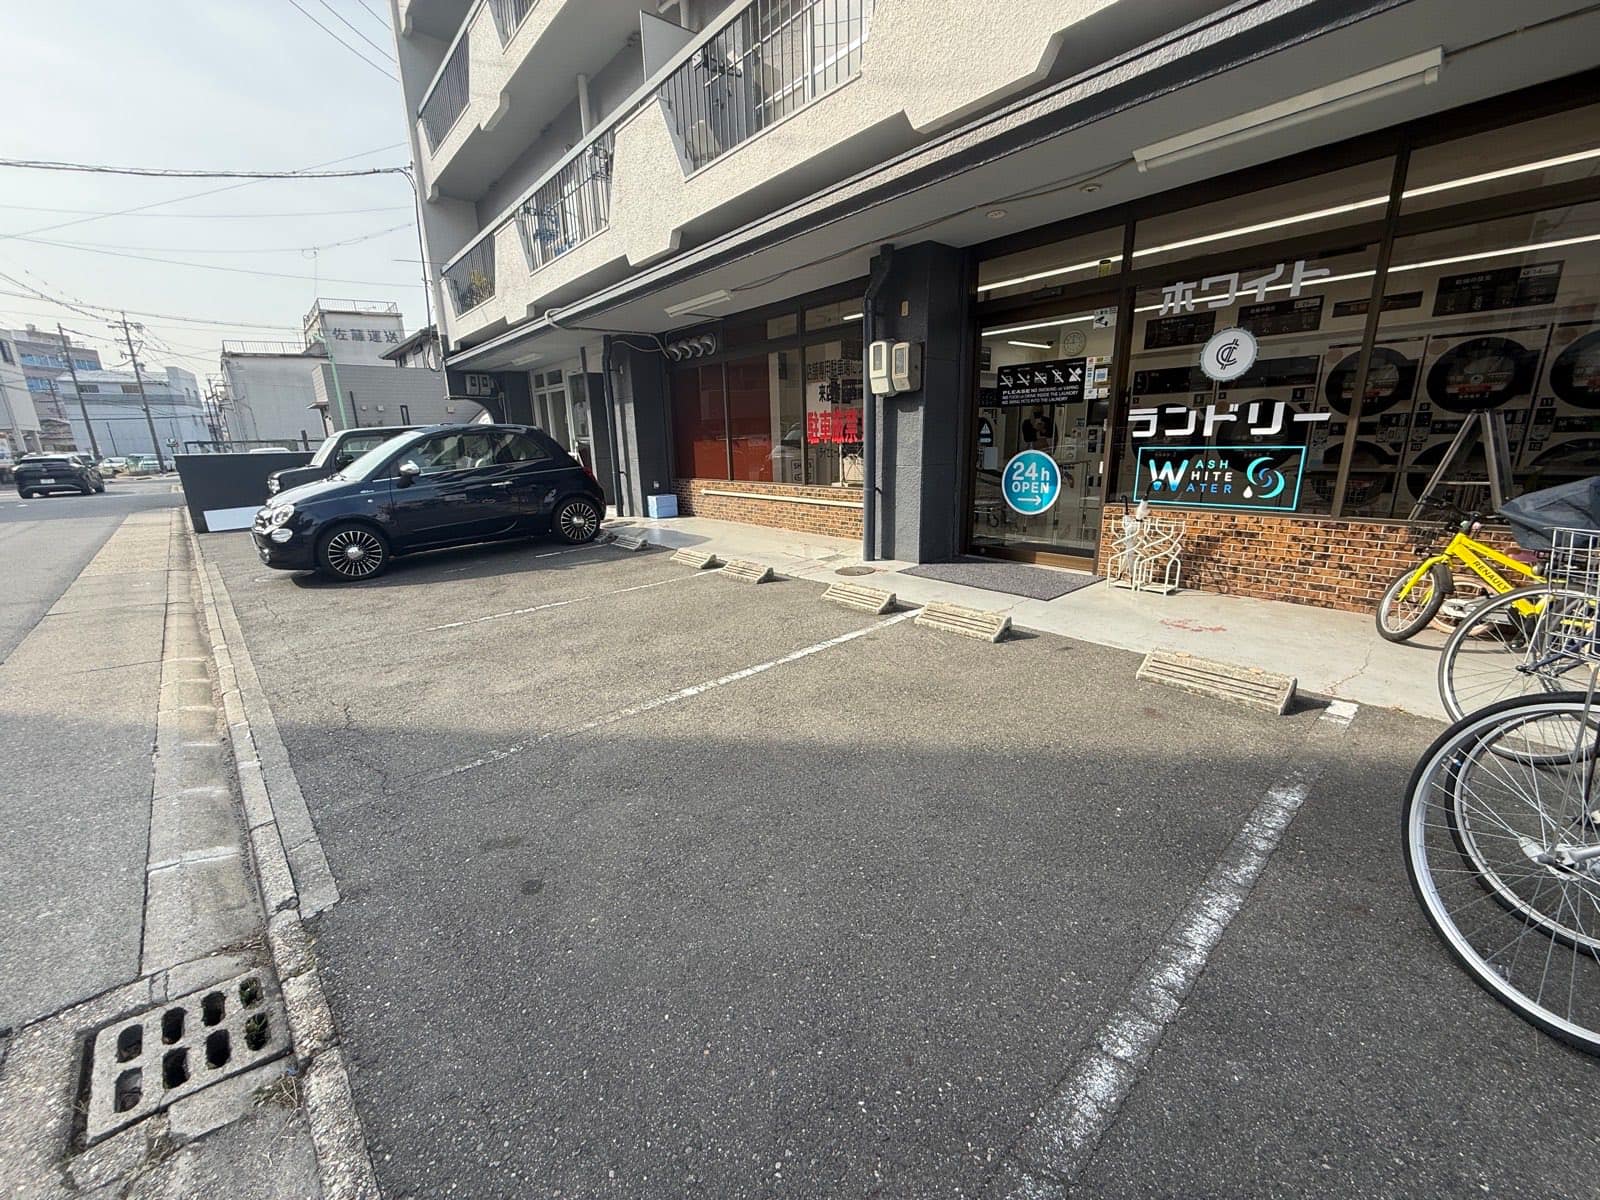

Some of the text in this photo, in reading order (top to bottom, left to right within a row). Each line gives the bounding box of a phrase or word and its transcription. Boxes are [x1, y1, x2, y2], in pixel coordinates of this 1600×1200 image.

[1158, 259, 1330, 317] ホワイト
[332, 328, 400, 344] 佐藤運送
[1002, 388, 1031, 396] PLEASE
[1127, 401, 1332, 438] ランドリー
[1011, 461, 1050, 481] 24h
[1011, 481, 1050, 494] OPEN
[1473, 560, 1510, 591] RENAULT
